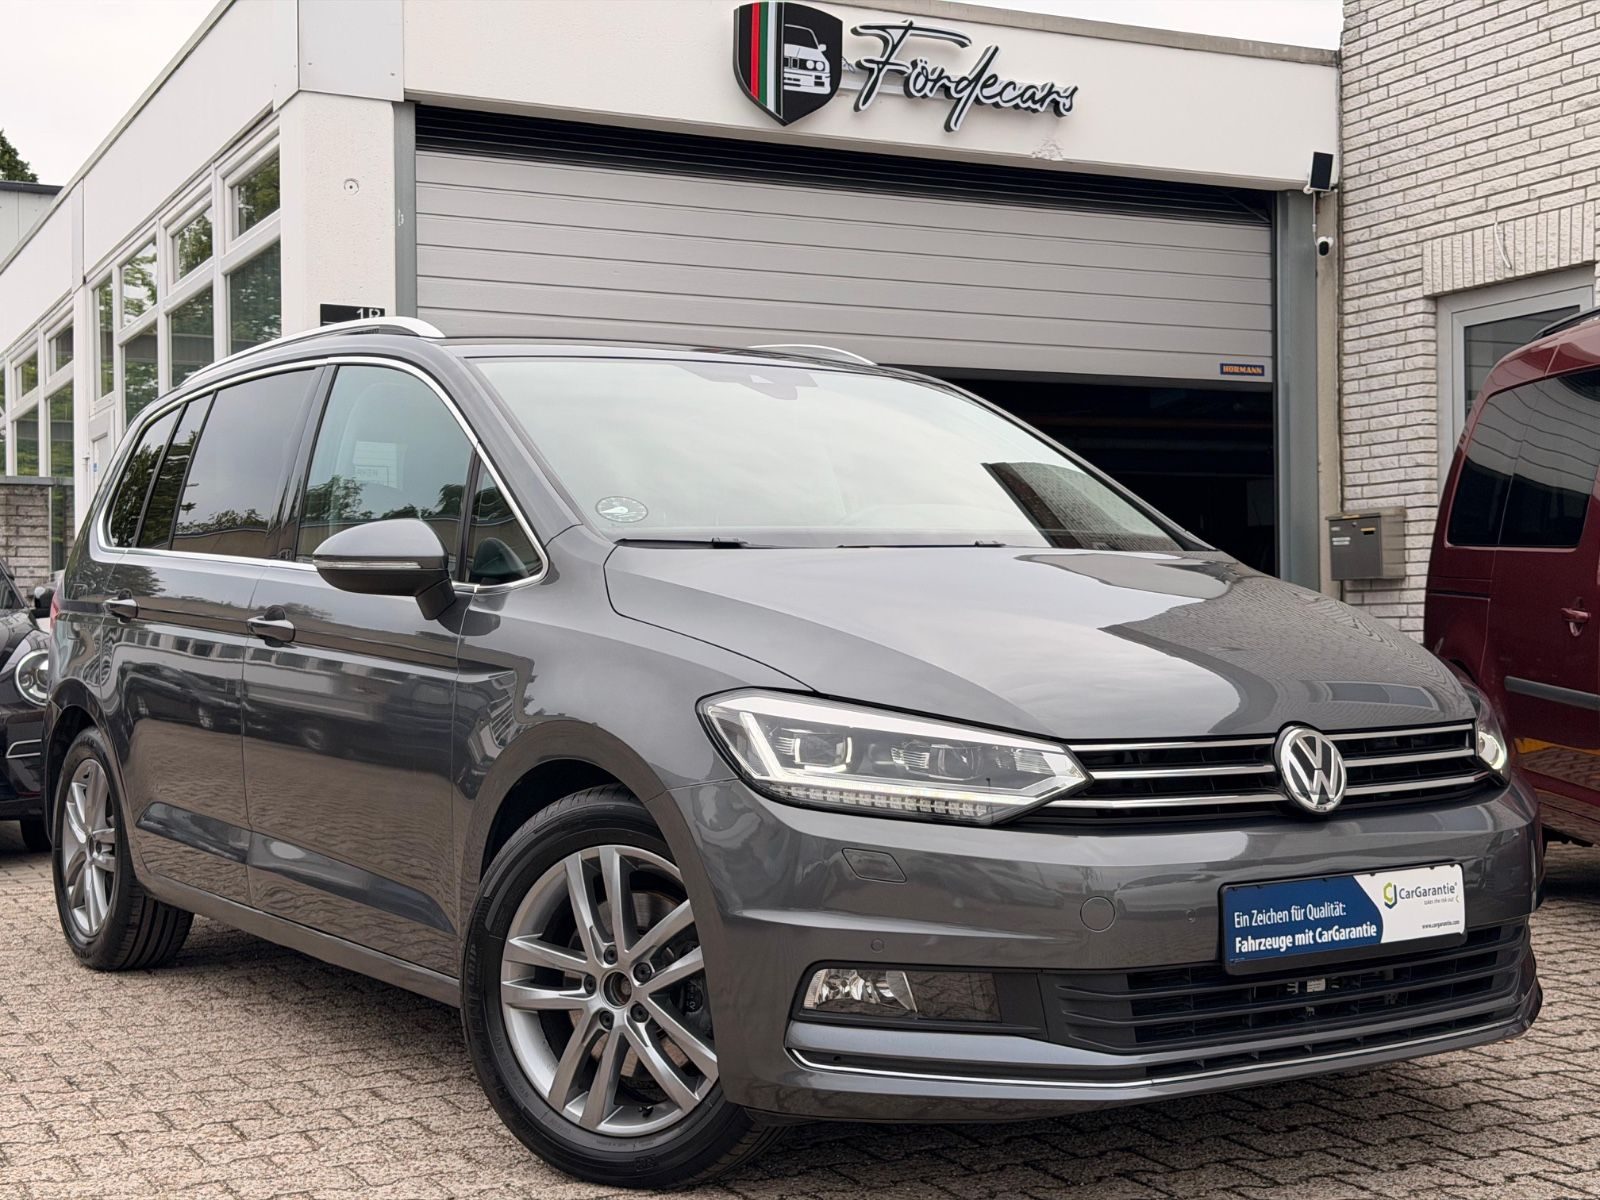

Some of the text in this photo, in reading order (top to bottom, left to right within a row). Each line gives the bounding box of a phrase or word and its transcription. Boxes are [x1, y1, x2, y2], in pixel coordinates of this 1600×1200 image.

[851, 19, 1078, 132] Fördecars
[1234, 901, 1347, 928] Ein Zeichen für Qualität:
[1235, 922, 1377, 953] Fahrzeuge mit CarGarantie
